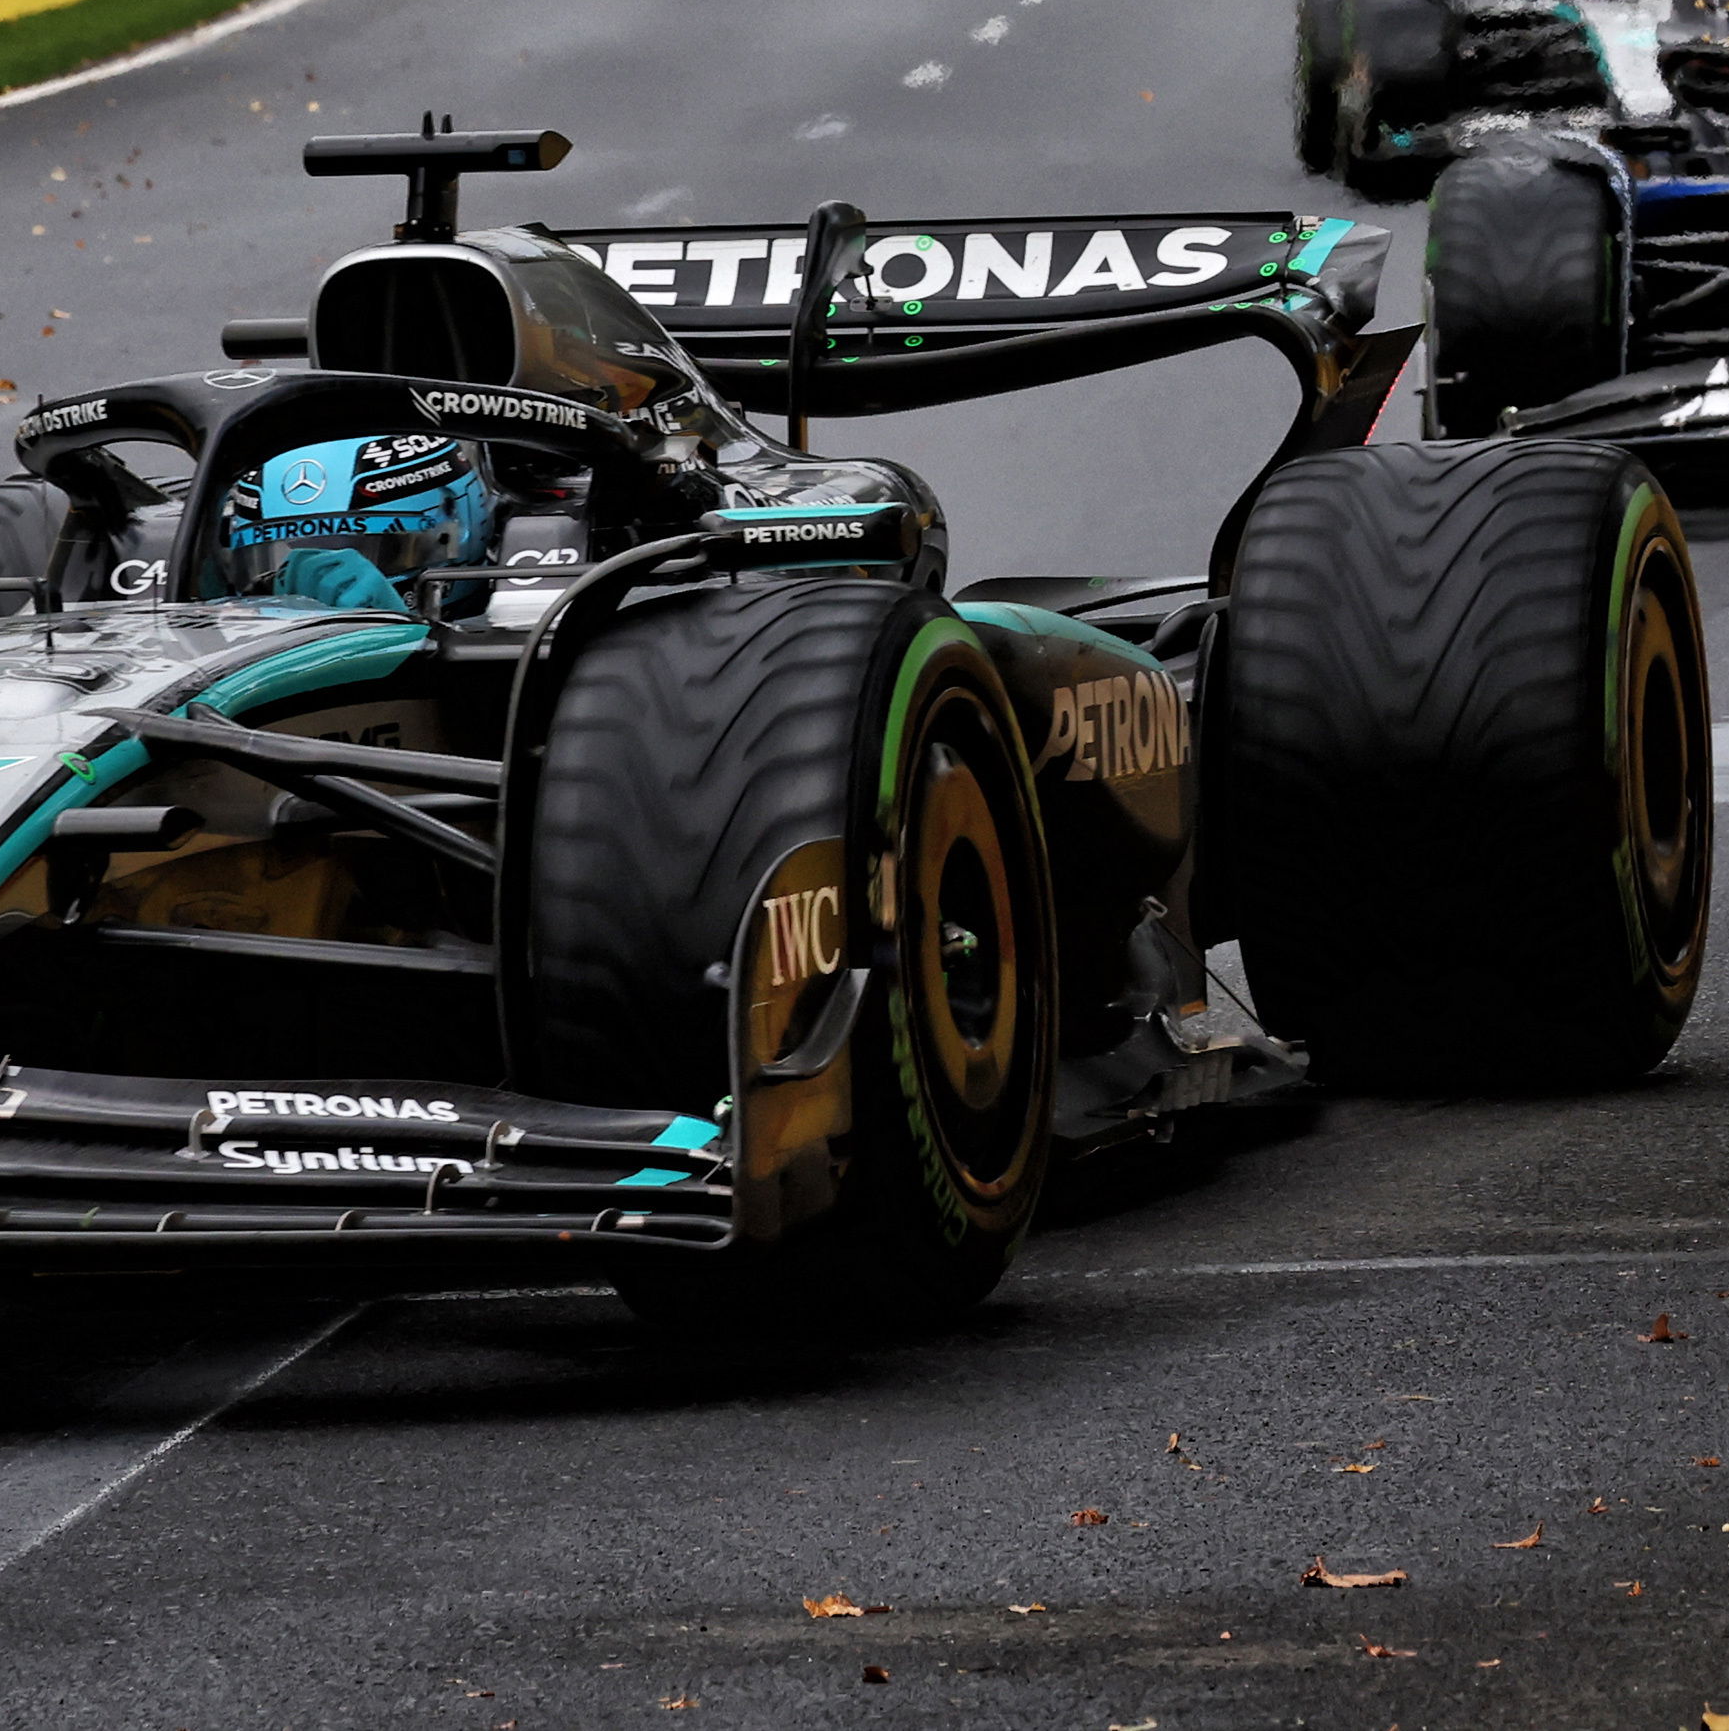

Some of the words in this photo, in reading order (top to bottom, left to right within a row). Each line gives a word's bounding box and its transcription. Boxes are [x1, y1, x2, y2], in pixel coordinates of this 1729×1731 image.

[426, 391, 587, 430] CROWDSTRIKE
[365, 461, 452, 493] CROWDSTRIKE
[253, 517, 368, 541] PETRONAS
[743, 522, 864, 544] PETRONAS
[763, 886, 840, 986] IWC
[207, 1091, 460, 1122] PETRONAS
[218, 1141, 473, 1174] Syntium
